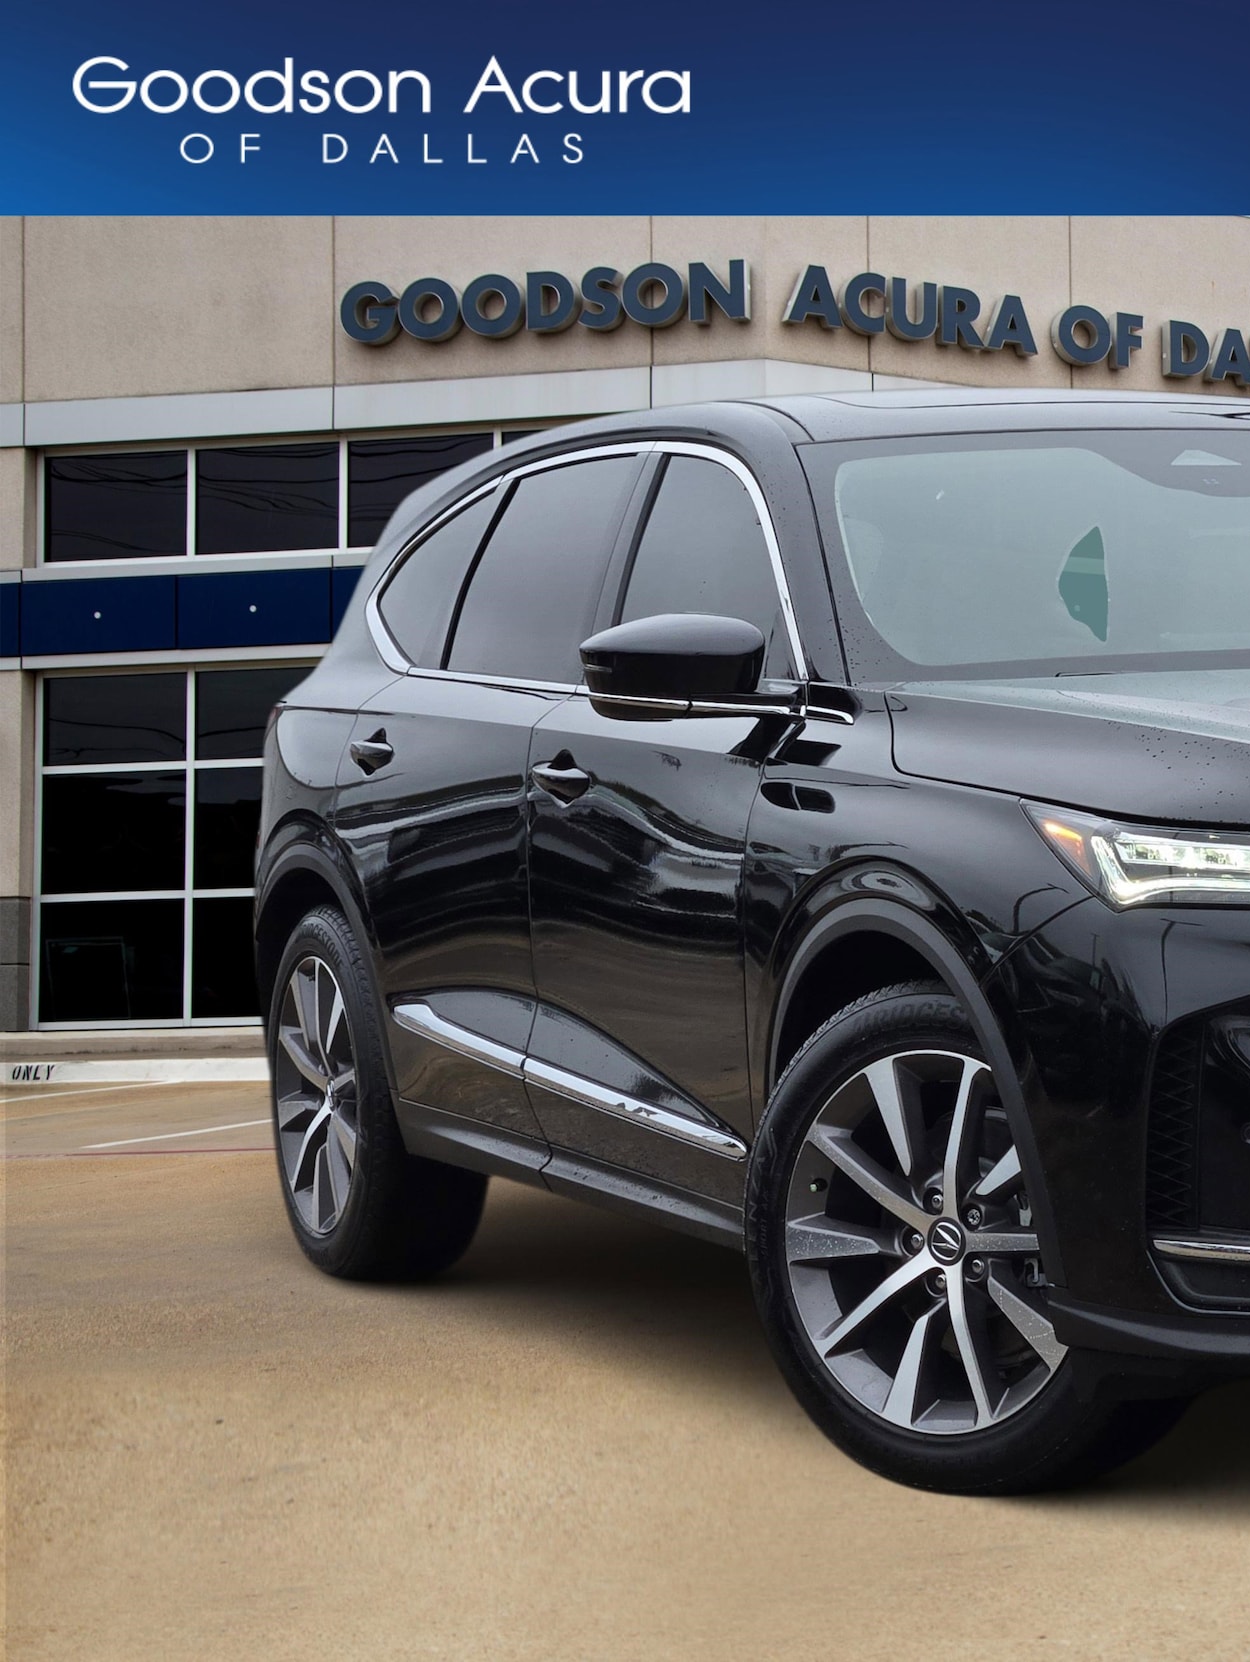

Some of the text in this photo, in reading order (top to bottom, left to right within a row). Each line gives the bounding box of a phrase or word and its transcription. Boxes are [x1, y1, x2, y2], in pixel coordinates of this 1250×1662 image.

[340, 259, 751, 347] GOODSON
[782, 264, 1038, 357] ACURA
[1051, 304, 1144, 371] OF
[853, 1001, 968, 1031] BRIDGES
[12, 1064, 55, 1080] ONLY
